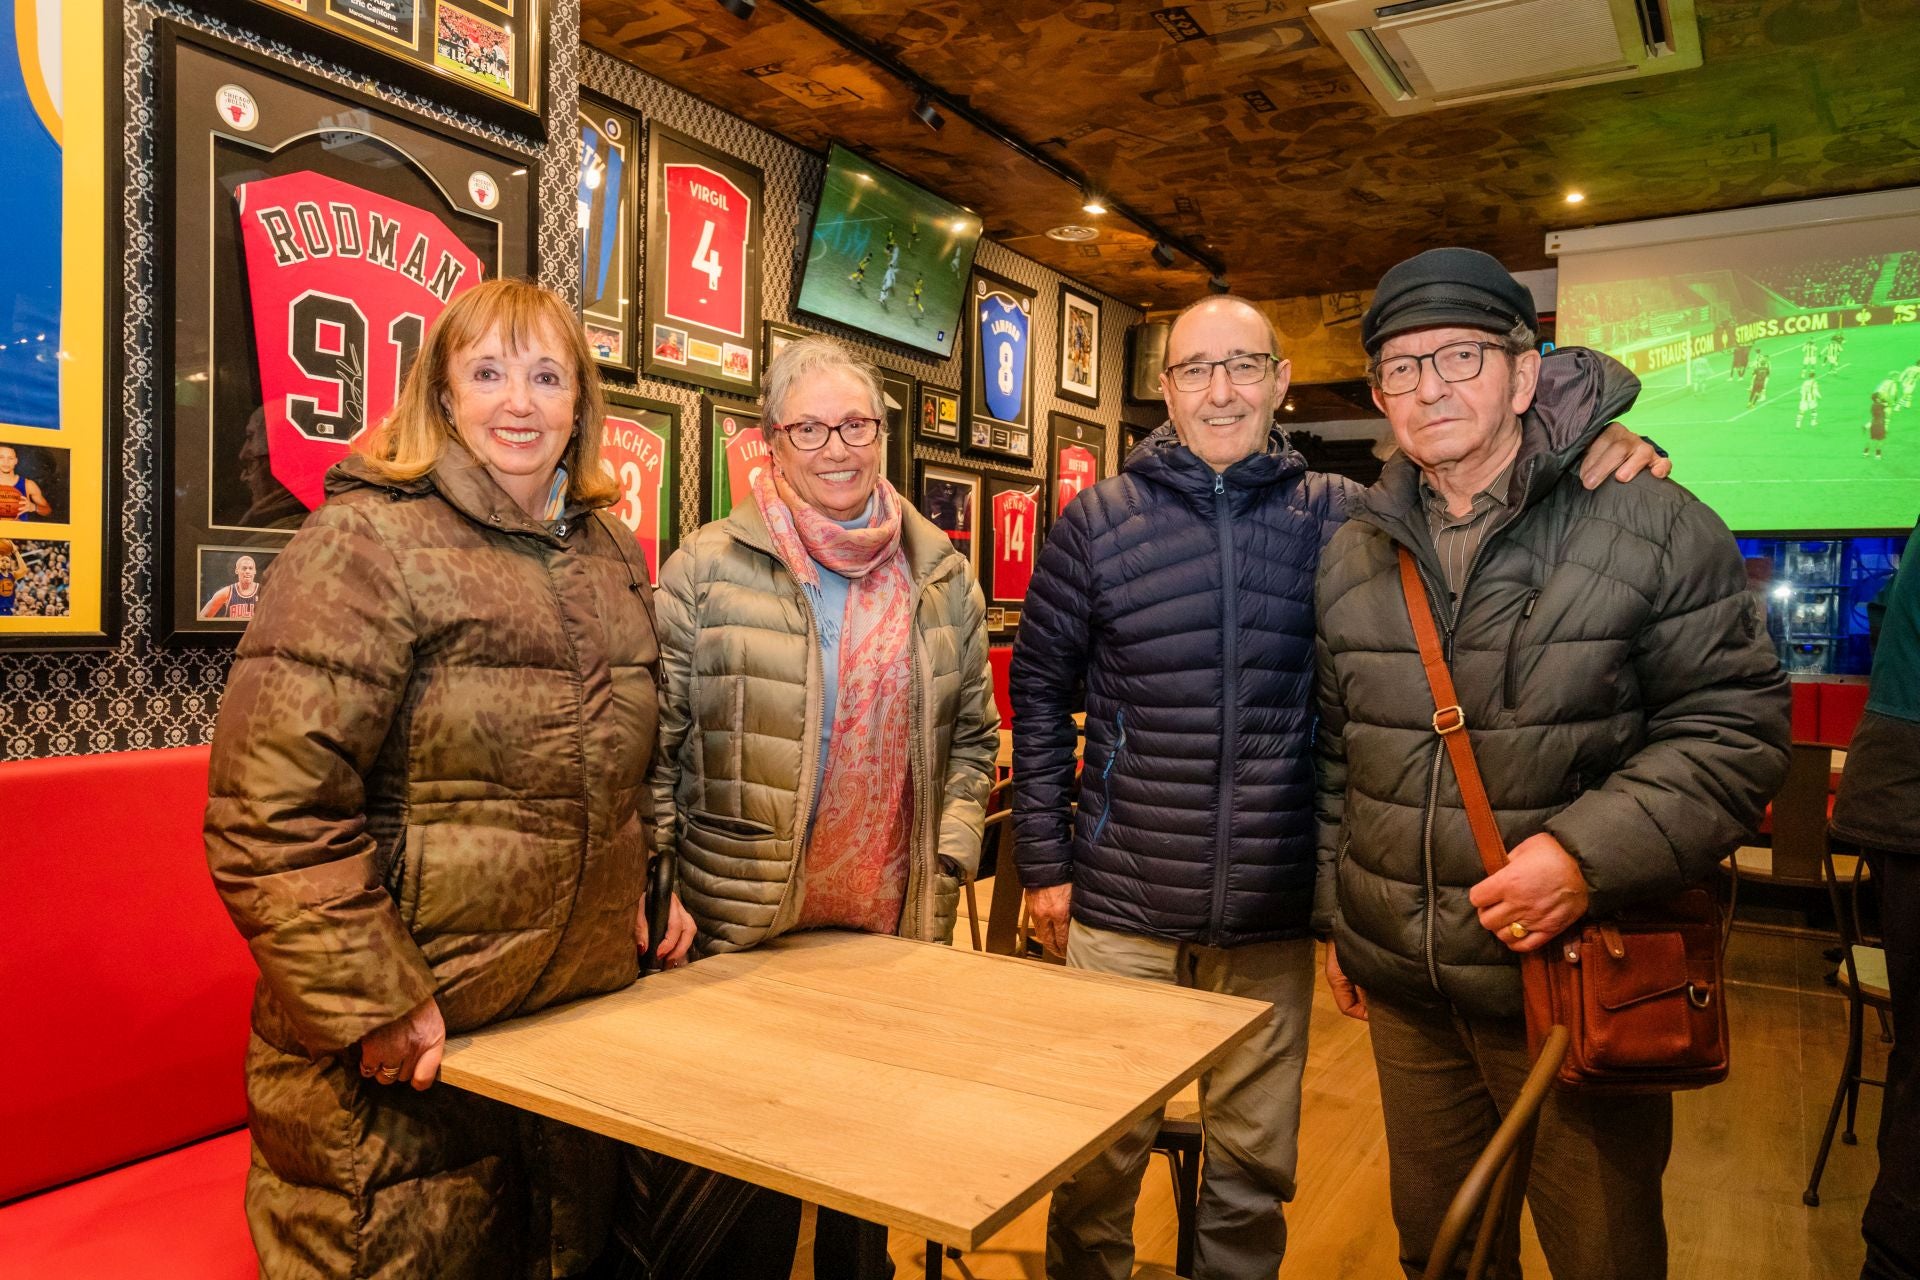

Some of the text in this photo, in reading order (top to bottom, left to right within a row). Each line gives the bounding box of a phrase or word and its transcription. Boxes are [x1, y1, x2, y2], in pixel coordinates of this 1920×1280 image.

[348, 7, 399, 33] Manchester United FC
[366, 2, 397, 22] Cantona
[689, 180, 730, 212] VIRGIL
[256, 201, 466, 305] RODMAN
[691, 219, 723, 291] 4
[1734, 312, 1829, 344] STRAUSS.COM
[285, 288, 426, 445] 91
[997, 341, 1014, 396] 8
[739, 439, 771, 462] LITM
[1003, 496, 1027, 513] HENRY
[1004, 512, 1025, 562] 14
